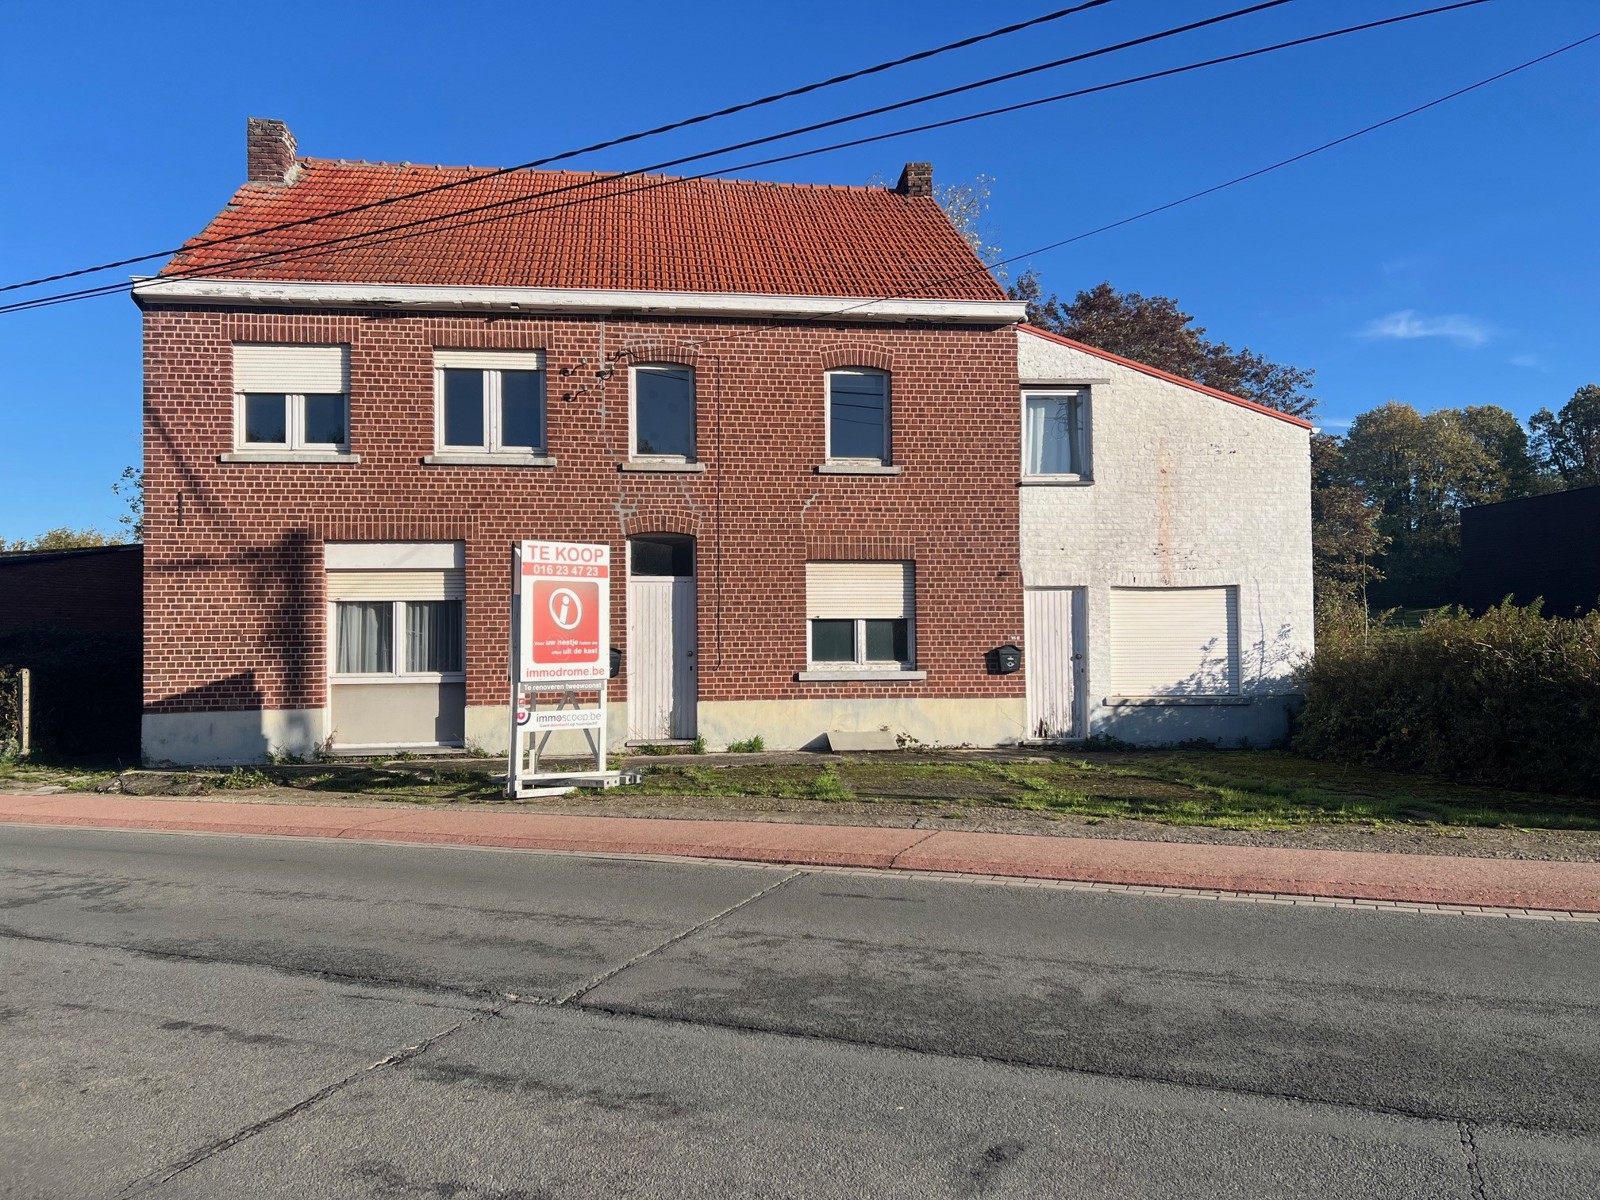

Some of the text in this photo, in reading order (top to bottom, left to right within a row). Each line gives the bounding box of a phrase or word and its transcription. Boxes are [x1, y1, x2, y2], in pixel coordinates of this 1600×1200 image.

[528, 545, 604, 562] TE KOOP
[533, 564, 599, 576] 016 23 47 23
[526, 666, 605, 677] immodrome.be
[536, 713, 602, 722] immoscoop.be
